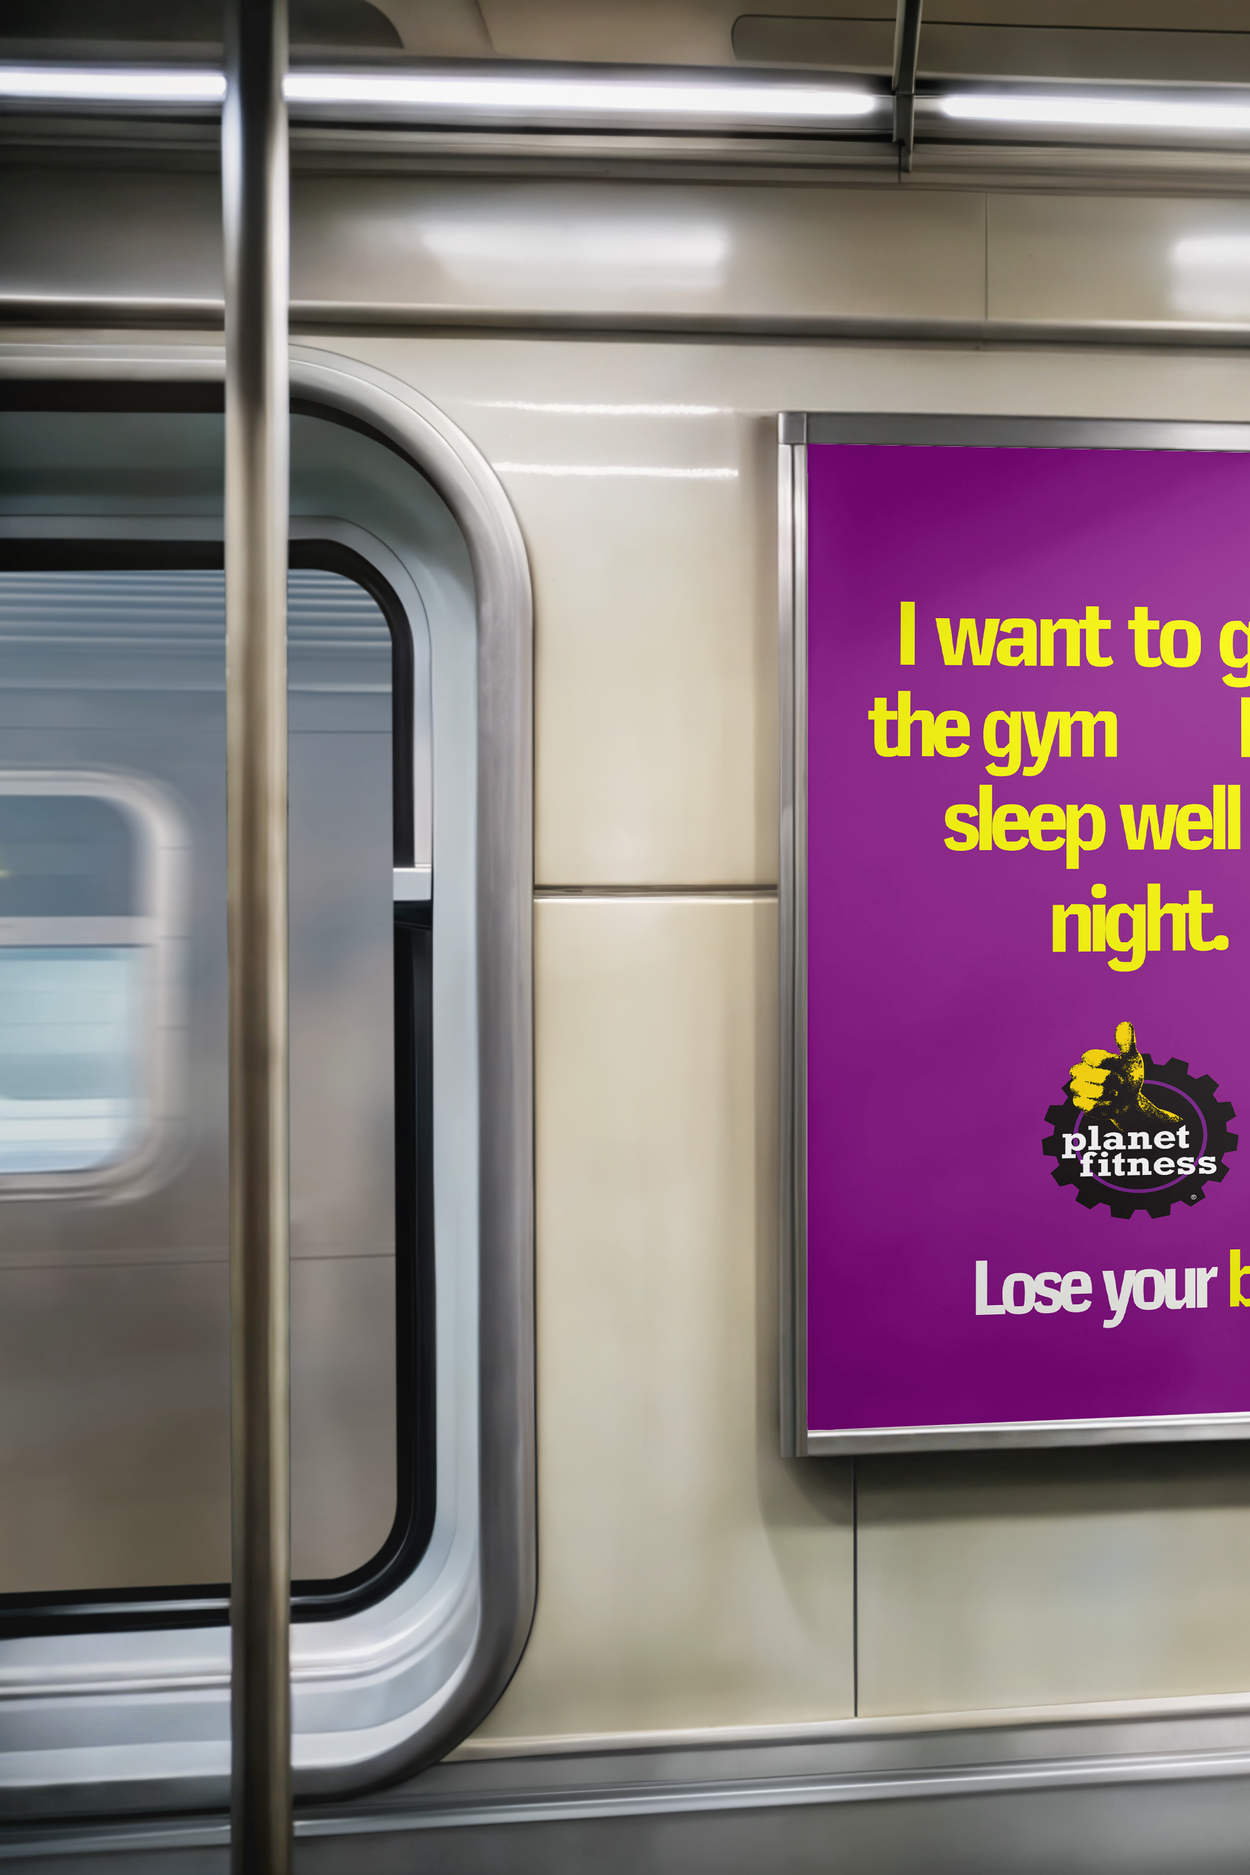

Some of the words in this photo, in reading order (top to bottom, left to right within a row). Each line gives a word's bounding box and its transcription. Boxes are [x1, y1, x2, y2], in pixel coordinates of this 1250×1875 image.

[900, 602, 915, 665] I
[935, 606, 1114, 667] want
[1128, 607, 1201, 668] to
[868, 691, 970, 757] the
[983, 711, 1117, 776] gym
[944, 785, 1106, 869] sleep
[1120, 785, 1240, 850] well
[1053, 883, 1229, 972] night.
[1061, 1124, 1190, 1159] planet
[1079, 1151, 1217, 1177] fitness
[976, 1261, 1092, 1315] Lose
[1102, 1267, 1218, 1328] your
